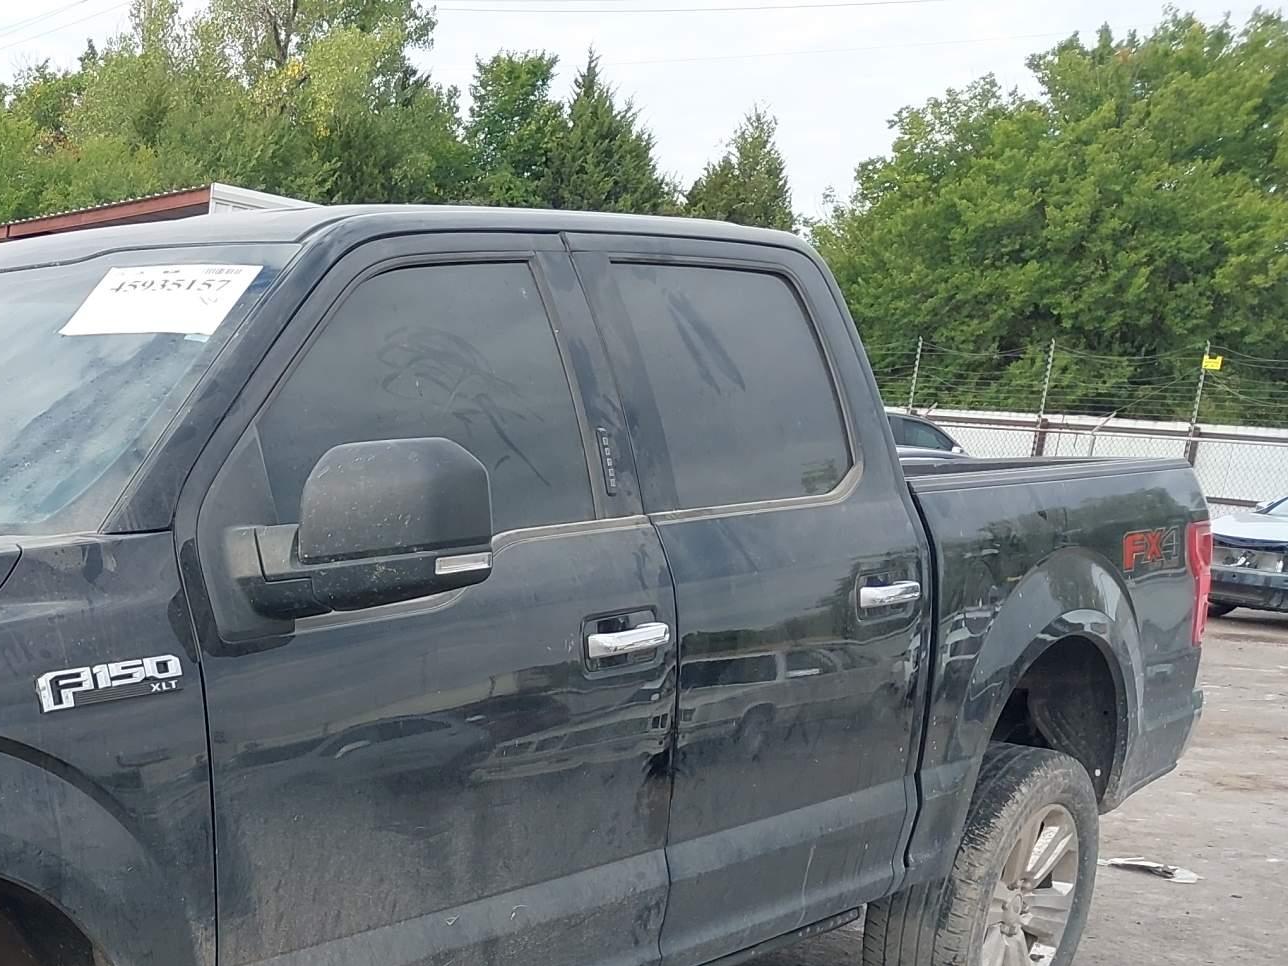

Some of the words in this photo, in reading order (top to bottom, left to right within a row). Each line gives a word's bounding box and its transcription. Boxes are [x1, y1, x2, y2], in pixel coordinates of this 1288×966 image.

[110, 279, 232, 293] 45935157
[1122, 525, 1180, 573] FX4
[150, 679, 179, 693] XLT
